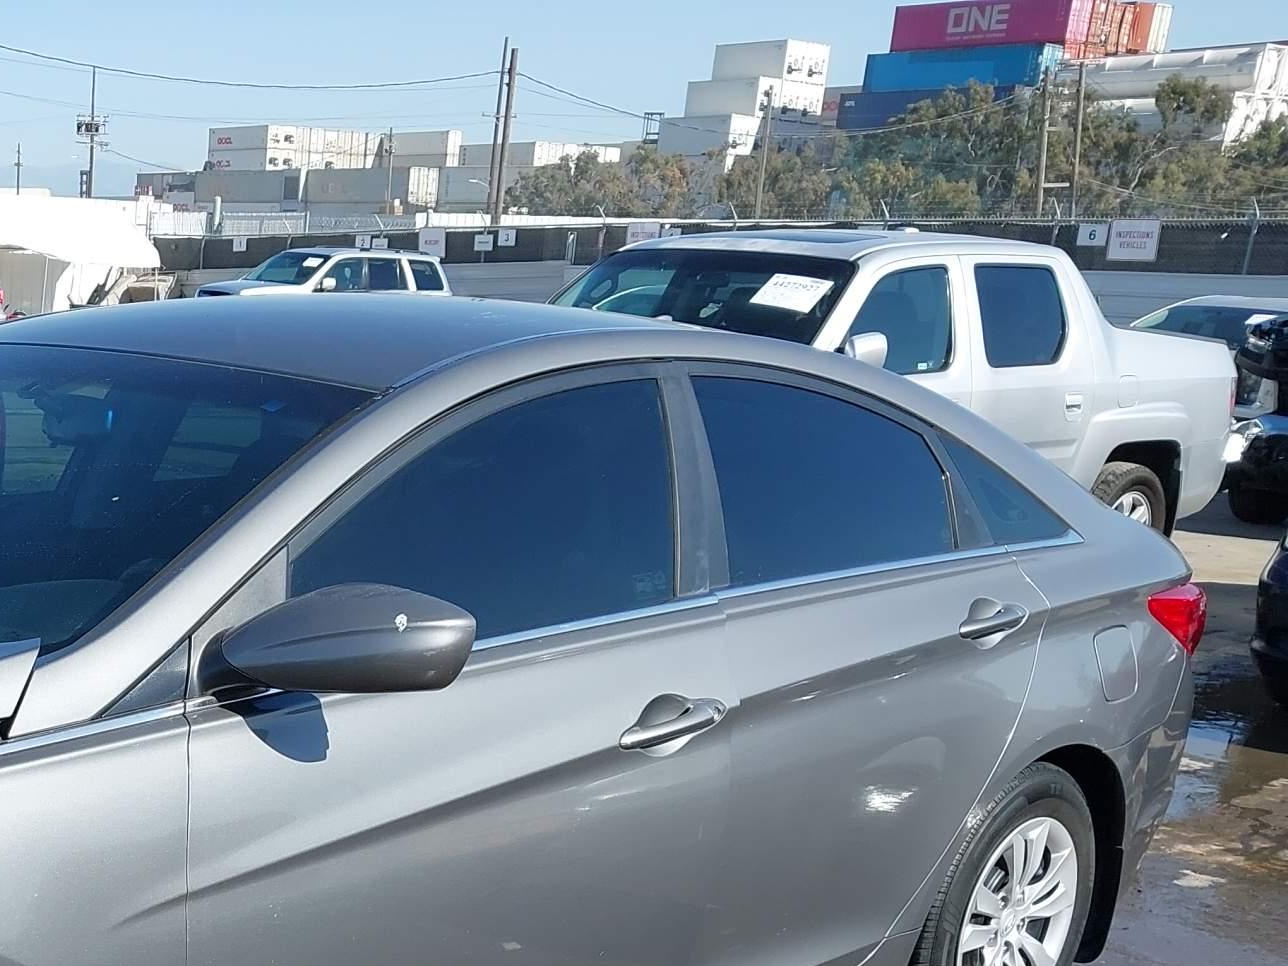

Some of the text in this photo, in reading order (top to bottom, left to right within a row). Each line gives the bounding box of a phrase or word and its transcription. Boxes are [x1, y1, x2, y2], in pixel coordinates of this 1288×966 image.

[947, 4, 1010, 33] ONE
[504, 233, 510, 242] 3
[1088, 229, 1097, 240] 6
